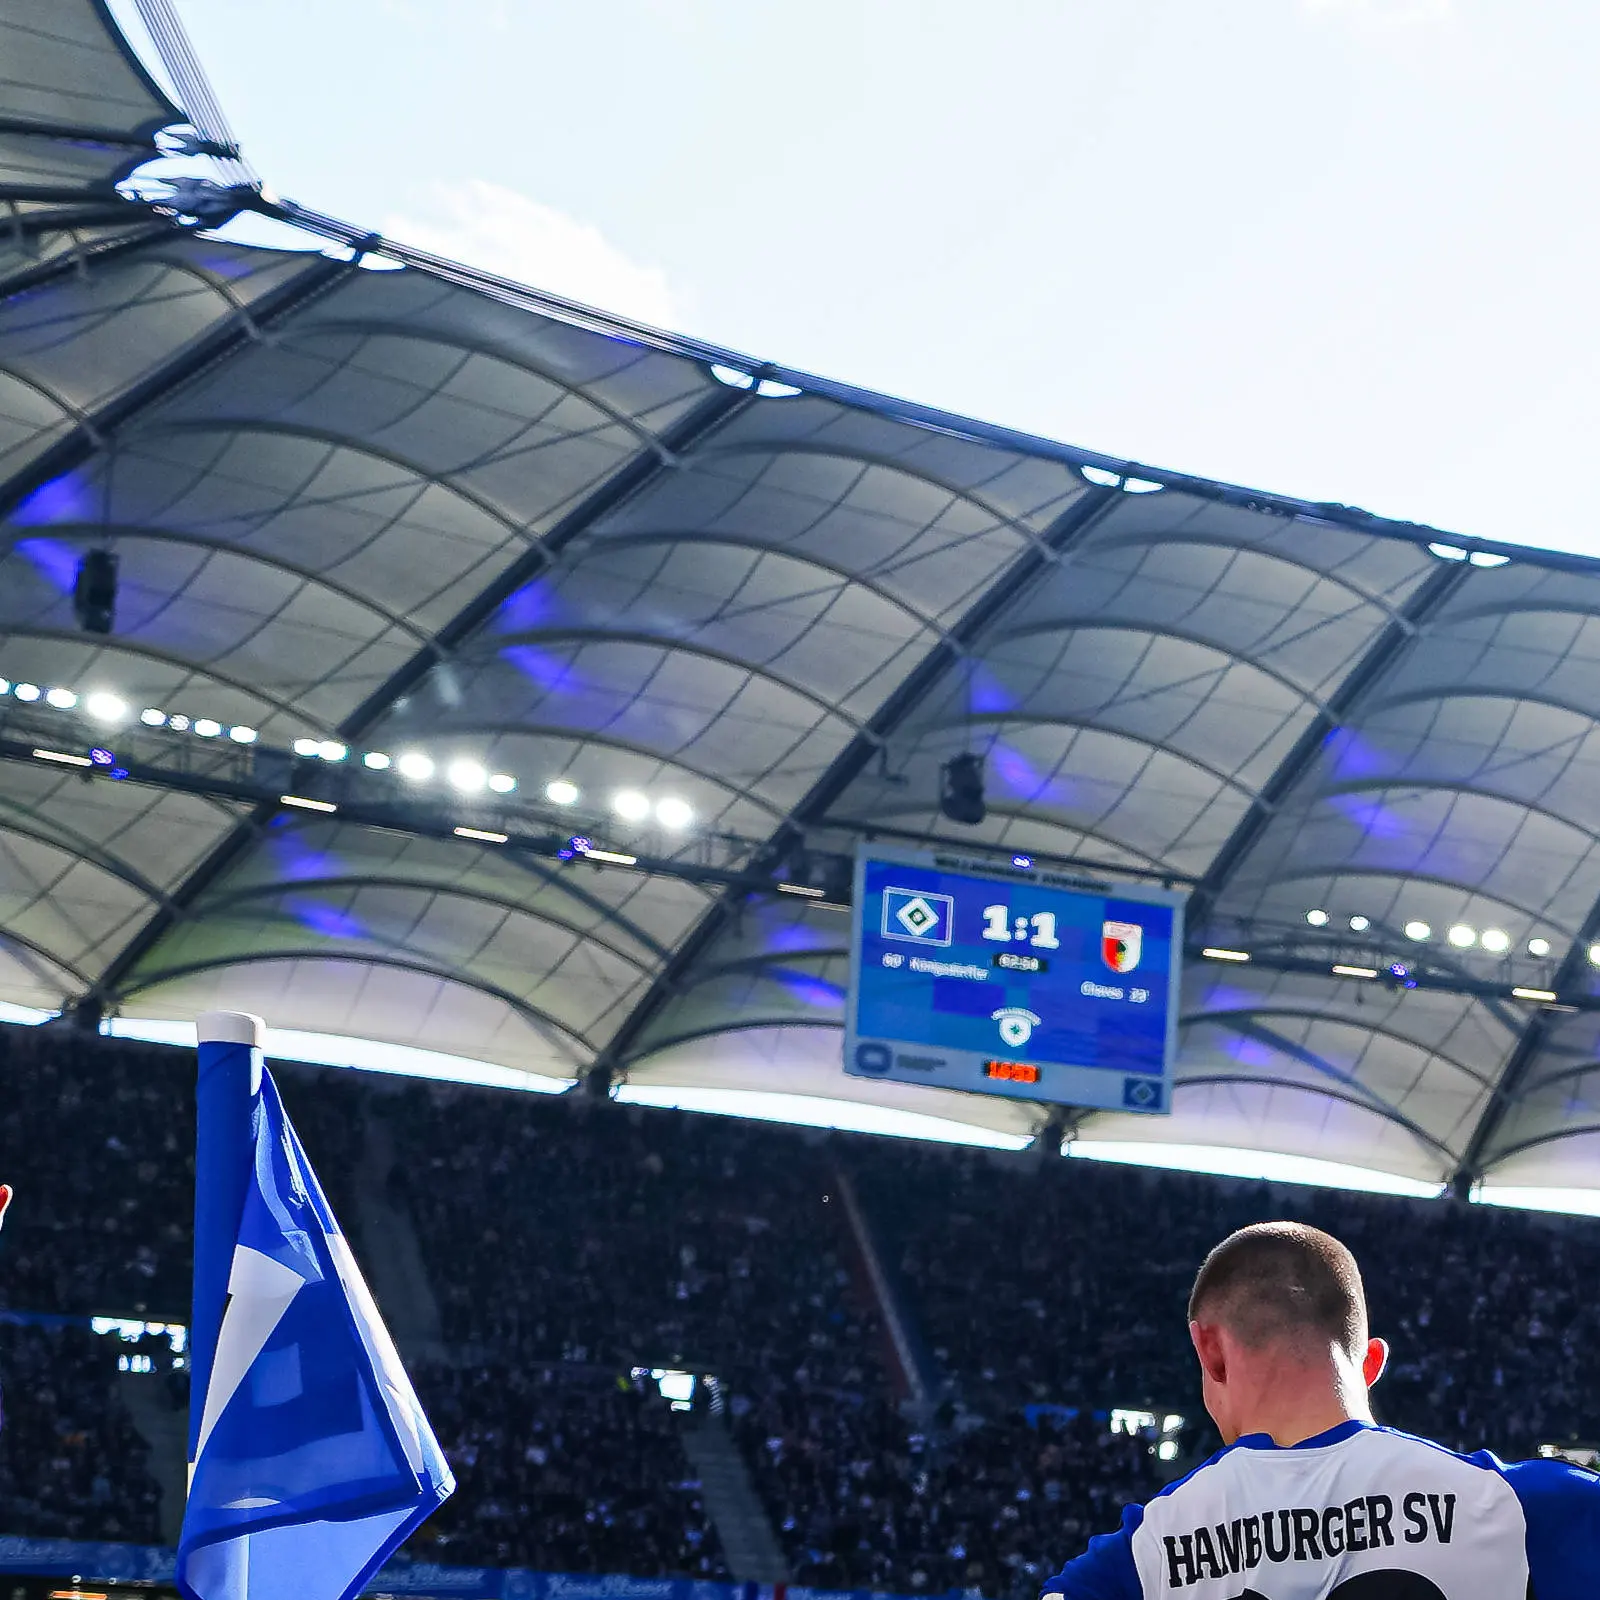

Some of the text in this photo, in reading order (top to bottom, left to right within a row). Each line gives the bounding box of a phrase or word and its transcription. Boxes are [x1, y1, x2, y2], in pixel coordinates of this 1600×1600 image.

[982, 904, 1060, 949] 1:1
[1164, 1493, 1456, 1588] HAMBURGER SV
